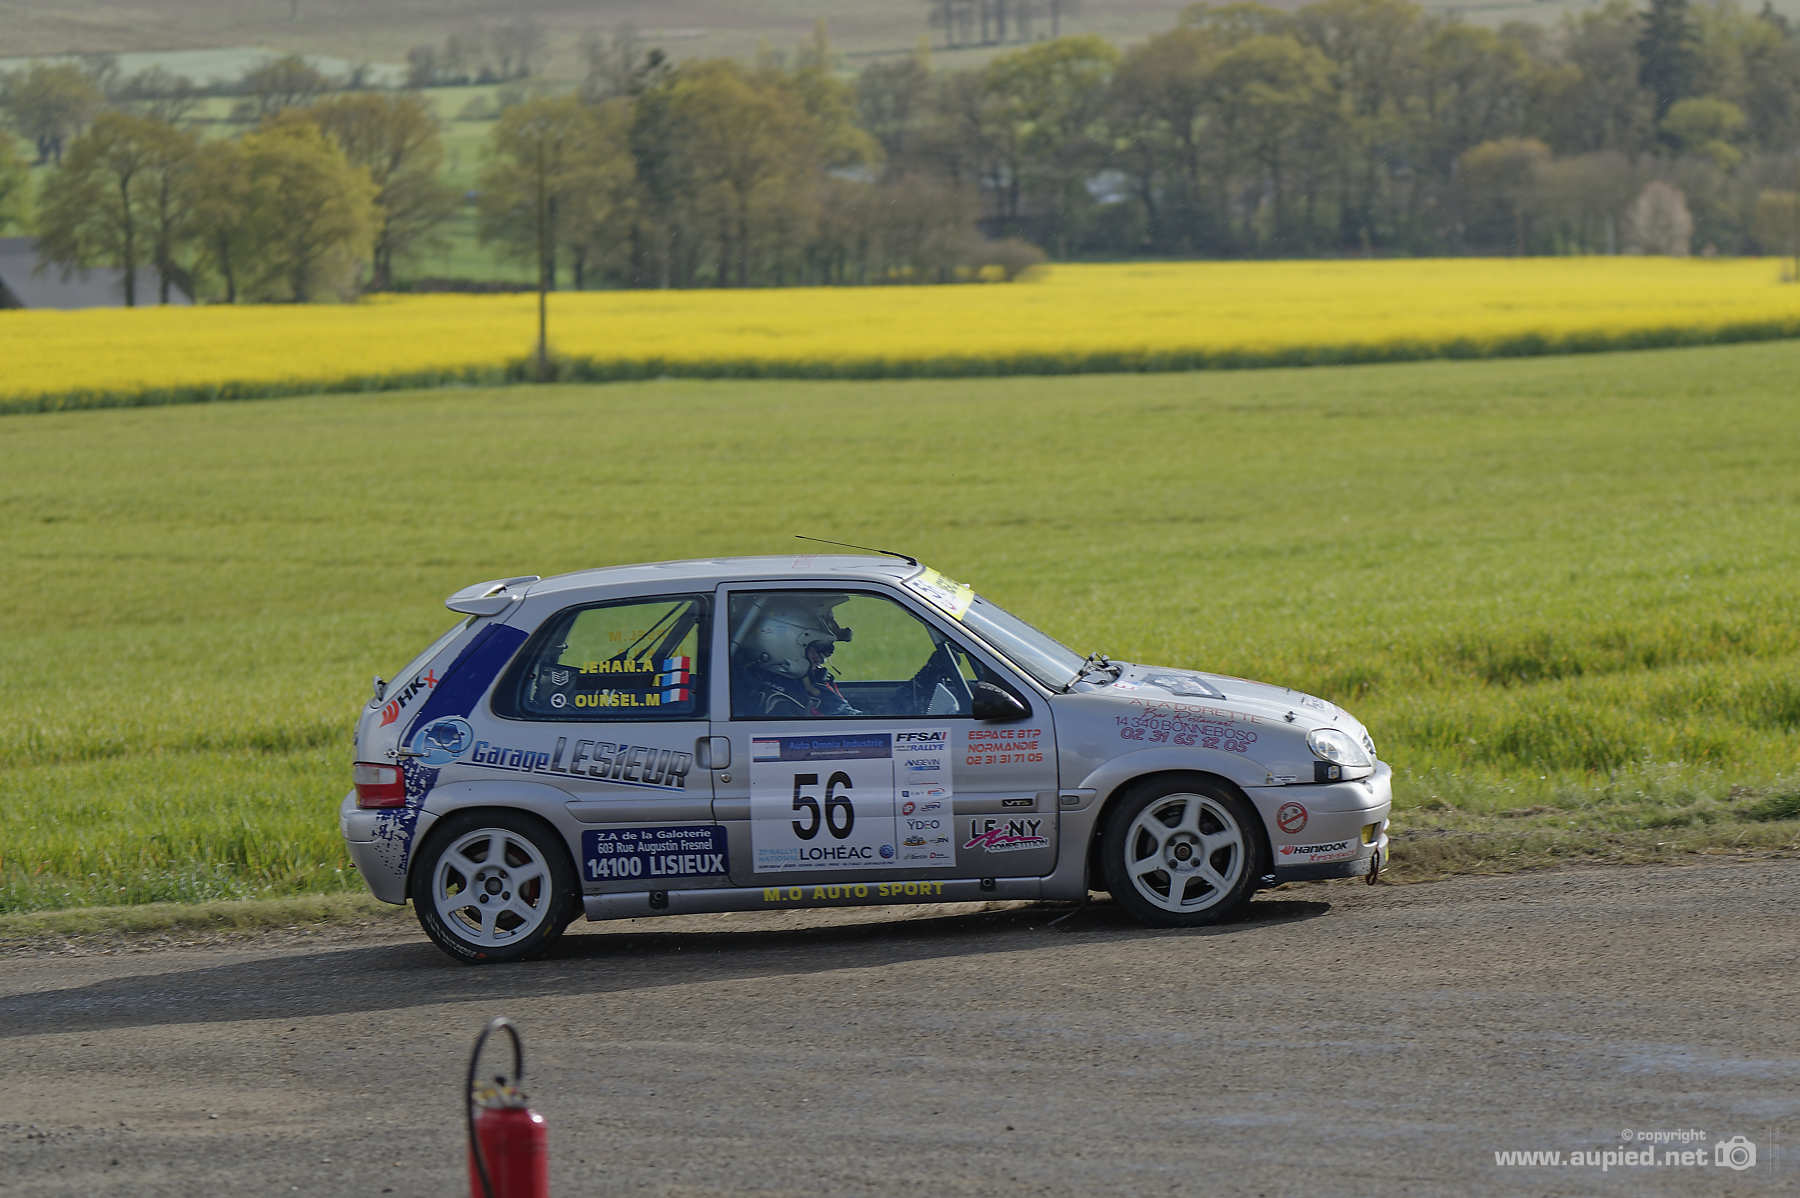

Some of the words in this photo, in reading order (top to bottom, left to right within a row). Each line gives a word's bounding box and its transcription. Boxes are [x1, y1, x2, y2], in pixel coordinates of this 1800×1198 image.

[579, 660, 655, 674] JEHAN.A
[968, 730, 1015, 741] ESPACE
[1120, 727, 1145, 741] 02
[968, 741, 1039, 753] NORMANDIE
[472, 740, 549, 772] Garage
[966, 755, 982, 766] 02
[984, 755, 997, 765] 31
[1000, 754, 1011, 764] 31
[1014, 753, 1025, 763] 71
[1027, 752, 1043, 762] 05
[792, 771, 855, 840] 56
[622, 831, 637, 840] de
[641, 831, 653, 840] la
[656, 828, 712, 839] Galoterie
[1009, 819, 1042, 837] NY
[616, 842, 635, 853] Rue
[637, 840, 679, 855] Augustin
[681, 838, 713, 851] Fresnel
[800, 845, 872, 861] LOHÉAC
[587, 856, 642, 878] 14100
[649, 854, 725, 875] LISIEUX
[813, 884, 868, 899] AUTO
[879, 881, 944, 897] SPORT
